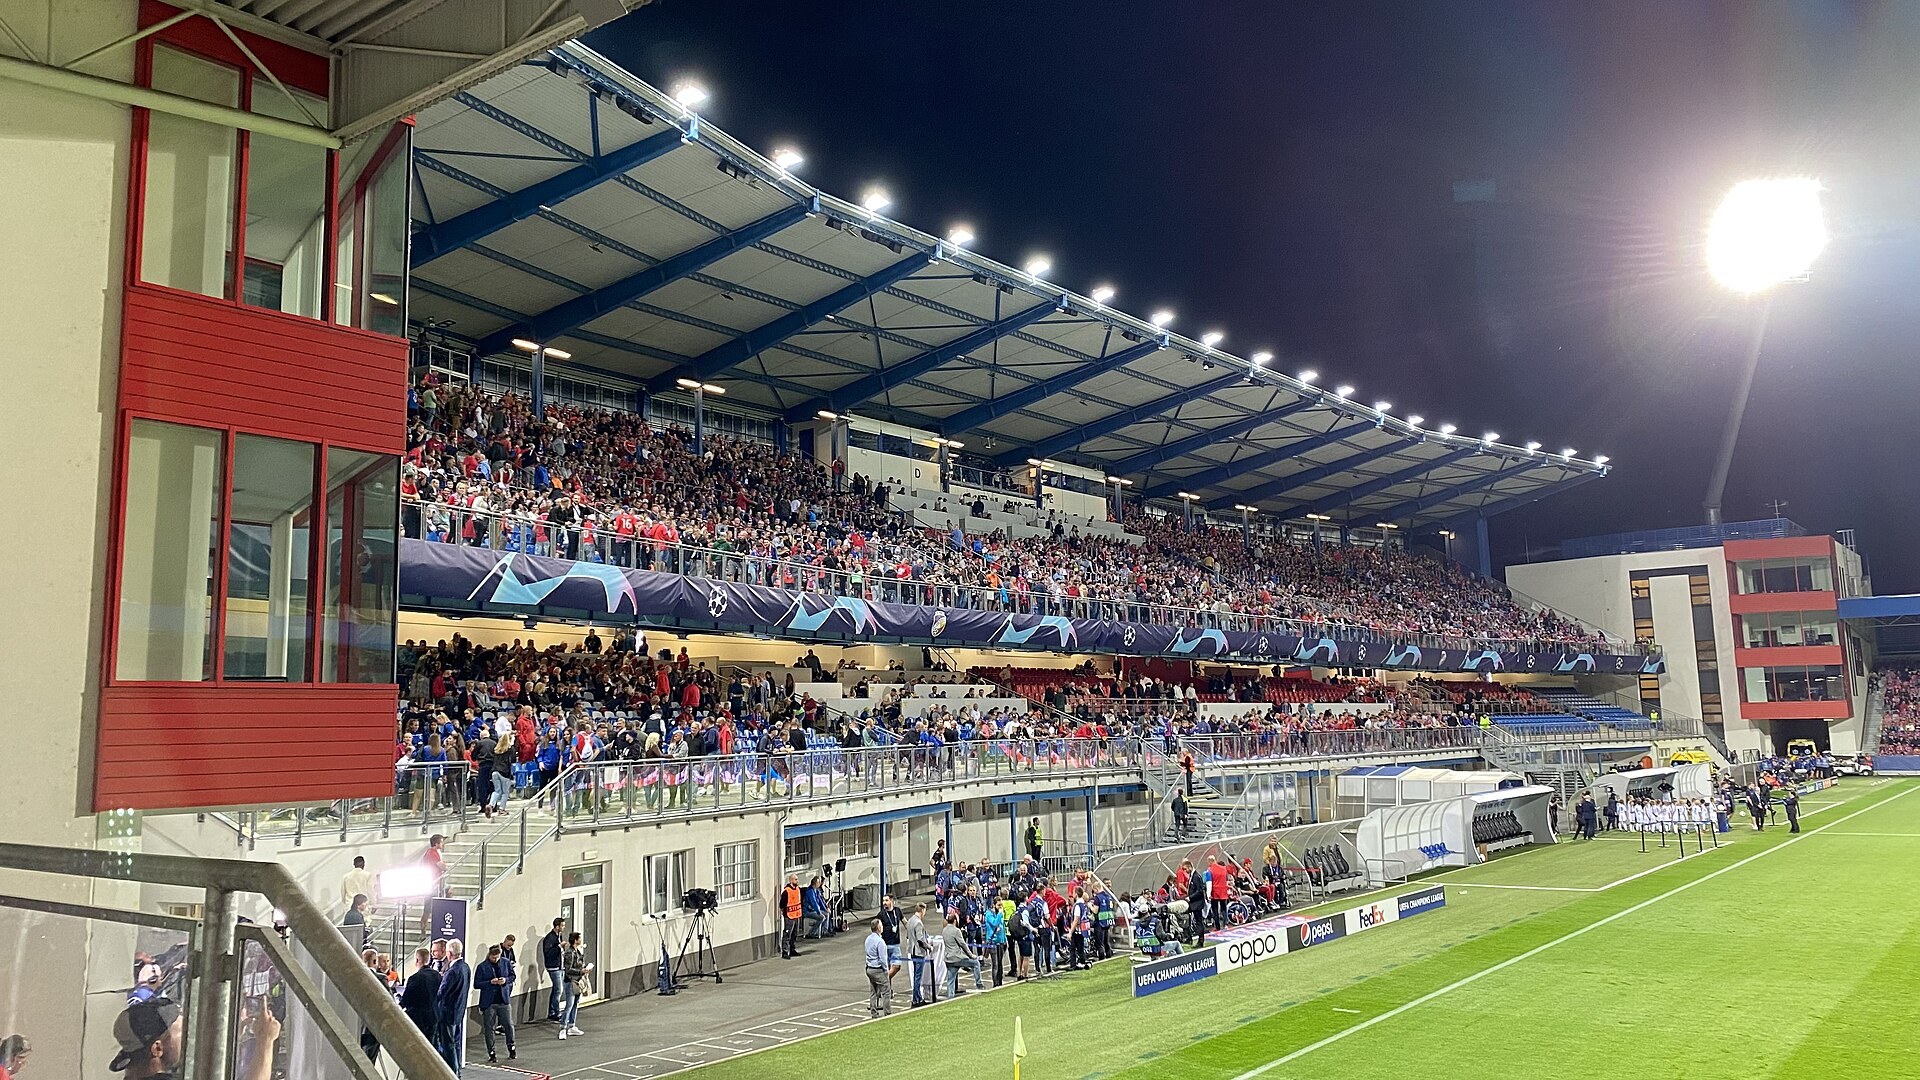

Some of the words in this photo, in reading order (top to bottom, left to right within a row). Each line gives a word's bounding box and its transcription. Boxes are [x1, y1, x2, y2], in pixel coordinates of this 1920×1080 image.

[914, 467, 921, 479] D
[621, 517, 633, 530] 16
[1399, 901, 1409, 912] UEFA
[1409, 895, 1431, 909] CHAMPIONS
[1430, 892, 1444, 902] LEAGUE
[1359, 904, 1385, 929] FedEx
[1311, 918, 1334, 943] pepsi
[1228, 934, 1277, 967] oppo
[1137, 972, 1156, 986] UEFA
[1156, 962, 1193, 982] CHAMPIONS
[1193, 956, 1215, 971] LEAGUE
